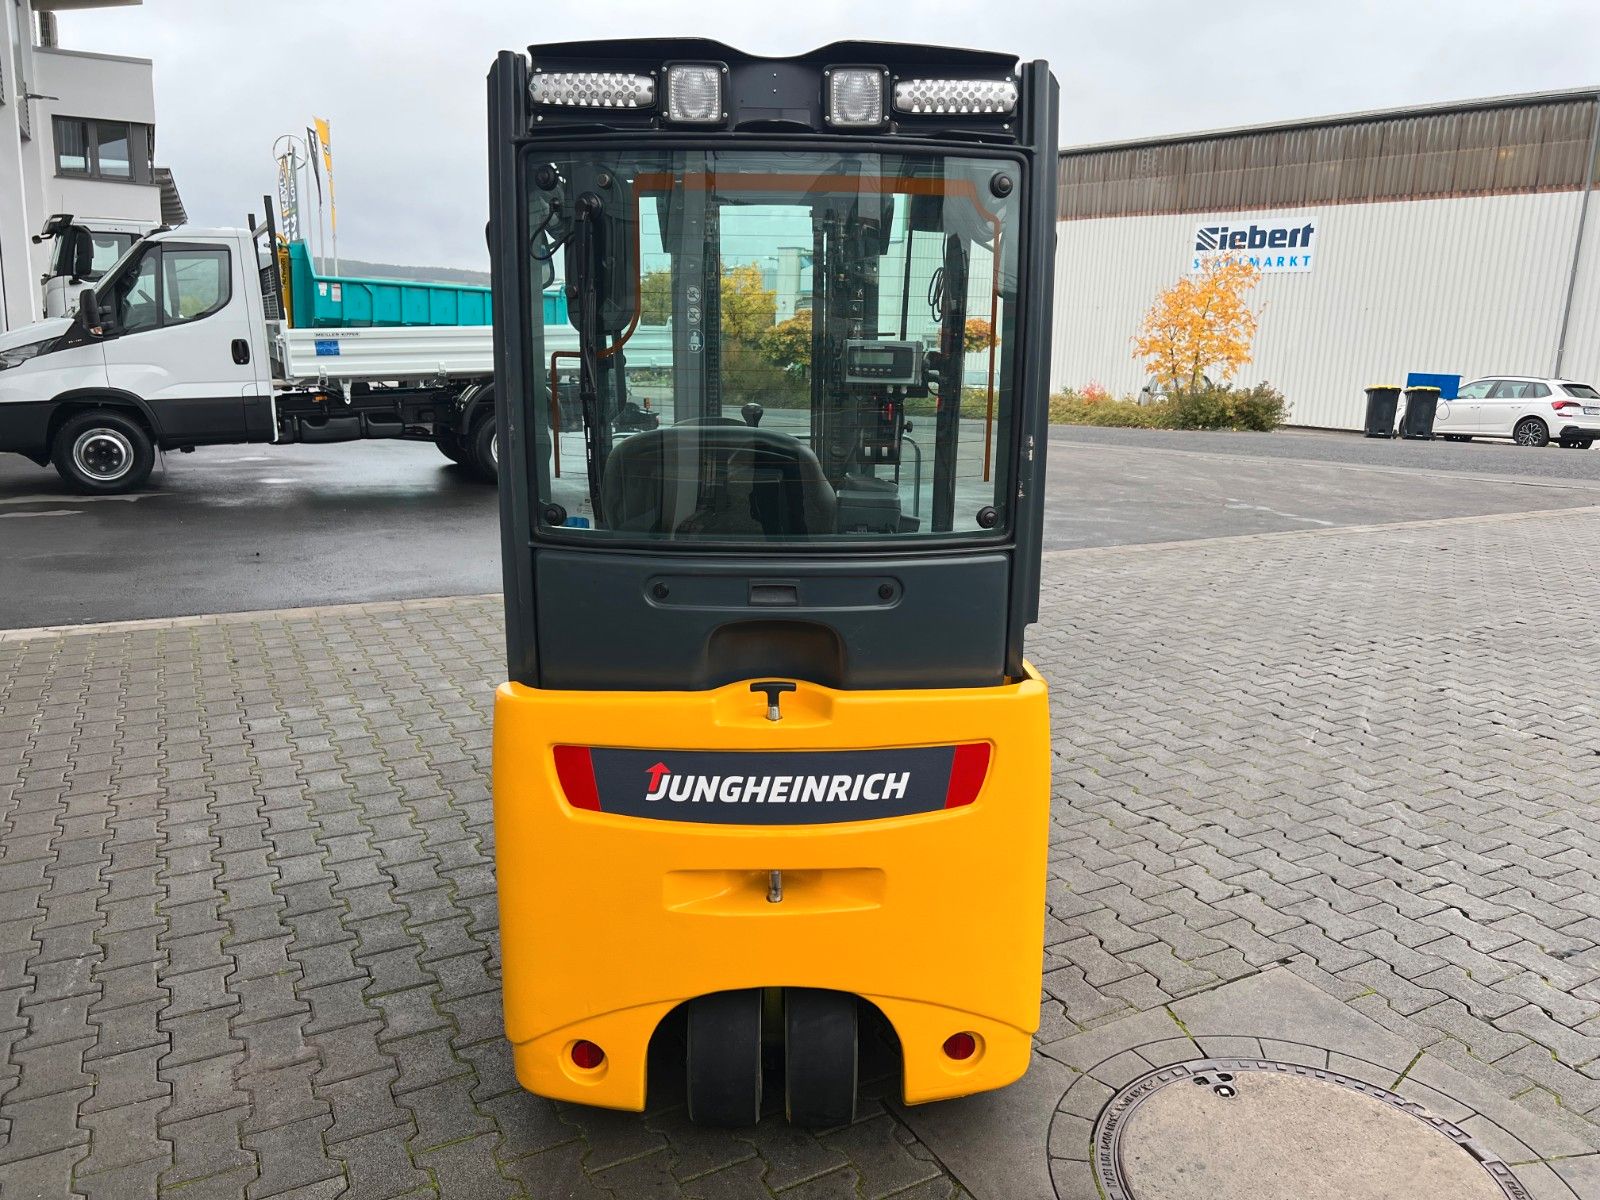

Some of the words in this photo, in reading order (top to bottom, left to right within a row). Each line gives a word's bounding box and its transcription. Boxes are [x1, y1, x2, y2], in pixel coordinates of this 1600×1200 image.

[1195, 223, 1315, 251] Siebert
[1193, 255, 1311, 269] SAMARKT
[645, 771, 911, 803] JUNGHEINRICH
